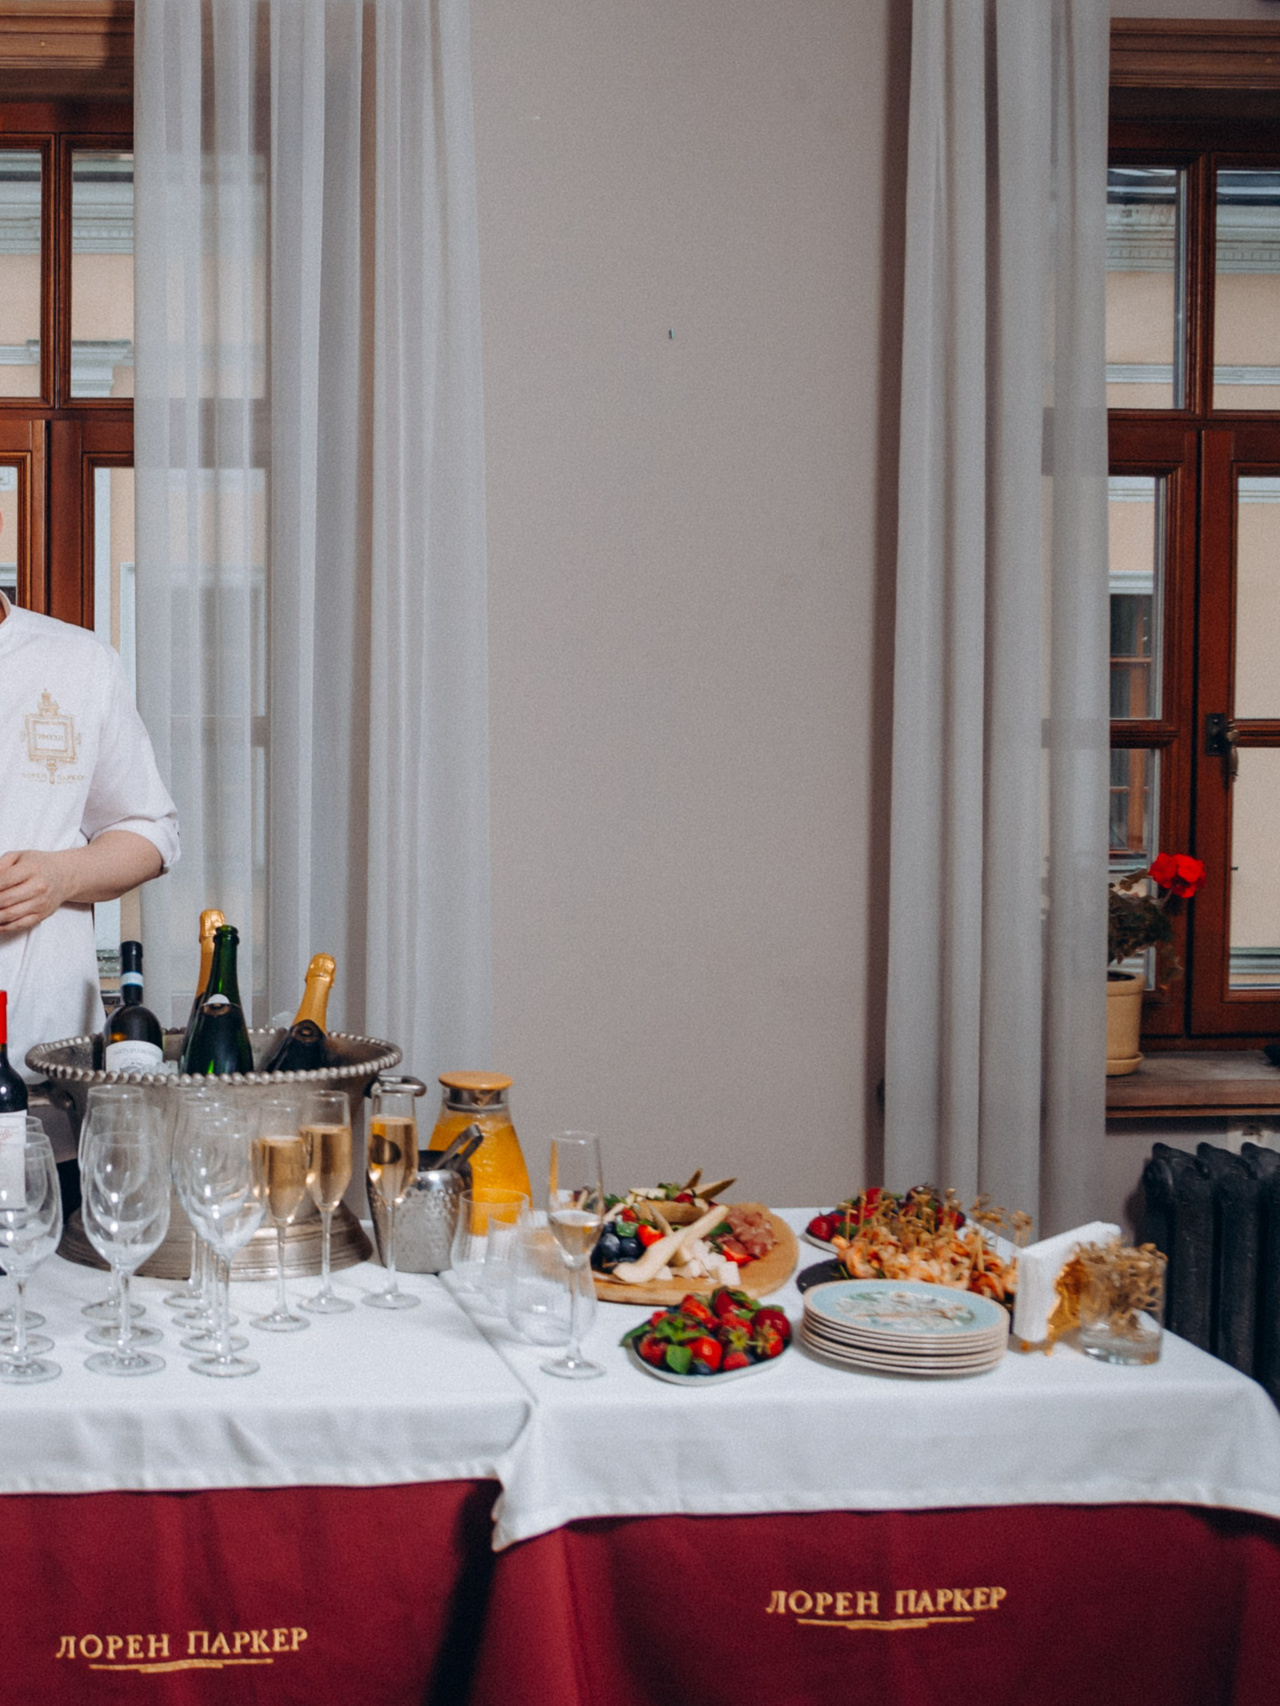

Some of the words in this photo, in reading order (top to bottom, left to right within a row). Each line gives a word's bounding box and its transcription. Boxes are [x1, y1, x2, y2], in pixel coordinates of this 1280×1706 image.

[765, 1589, 880, 1616] ЛОРЕН
[894, 1586, 1007, 1615] ПАРКЕР
[55, 1633, 170, 1659] ЛОРЕН
[187, 1626, 308, 1655] ПАРКЕР
